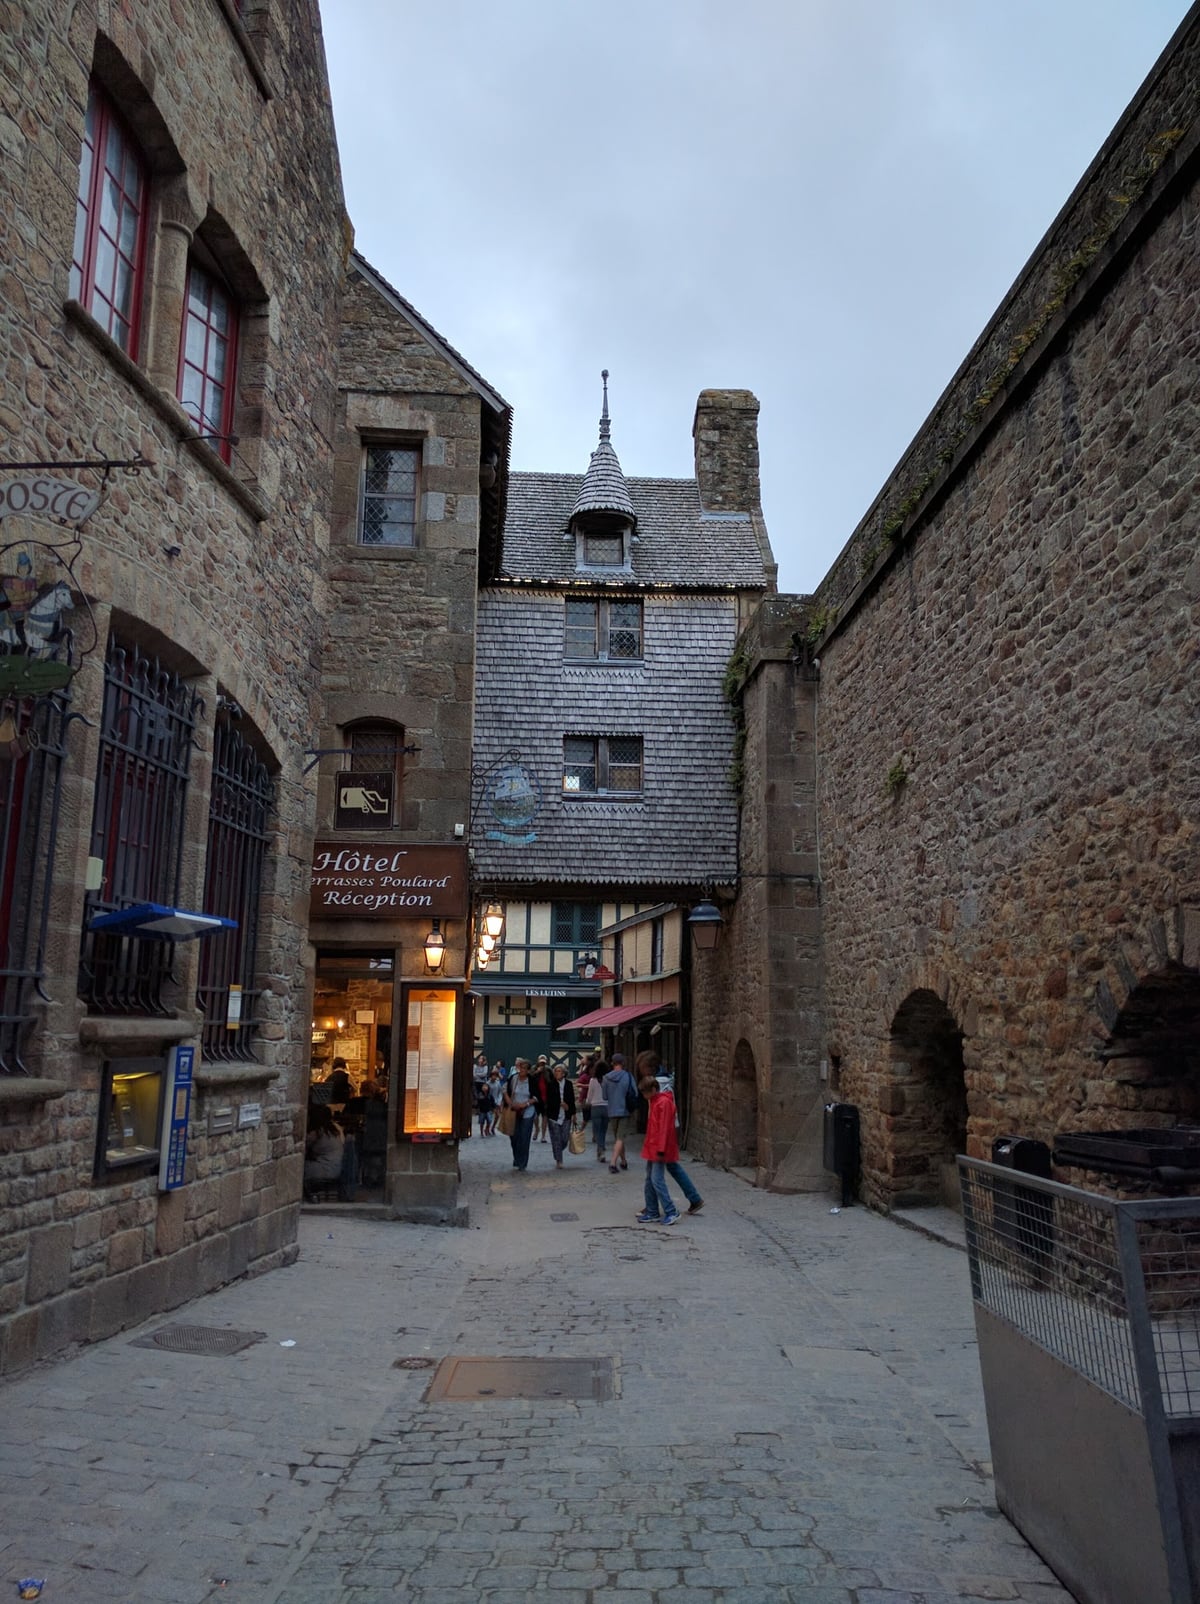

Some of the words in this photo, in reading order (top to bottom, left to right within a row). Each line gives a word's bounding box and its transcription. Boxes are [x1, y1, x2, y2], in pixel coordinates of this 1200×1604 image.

[0, 480, 91, 520] OSTE
[313, 849, 407, 872] Hôtel
[311, 876, 375, 887] errasses
[380, 875, 451, 888] Poulard
[323, 891, 433, 910] Réception
[525, 989, 539, 997] LES
